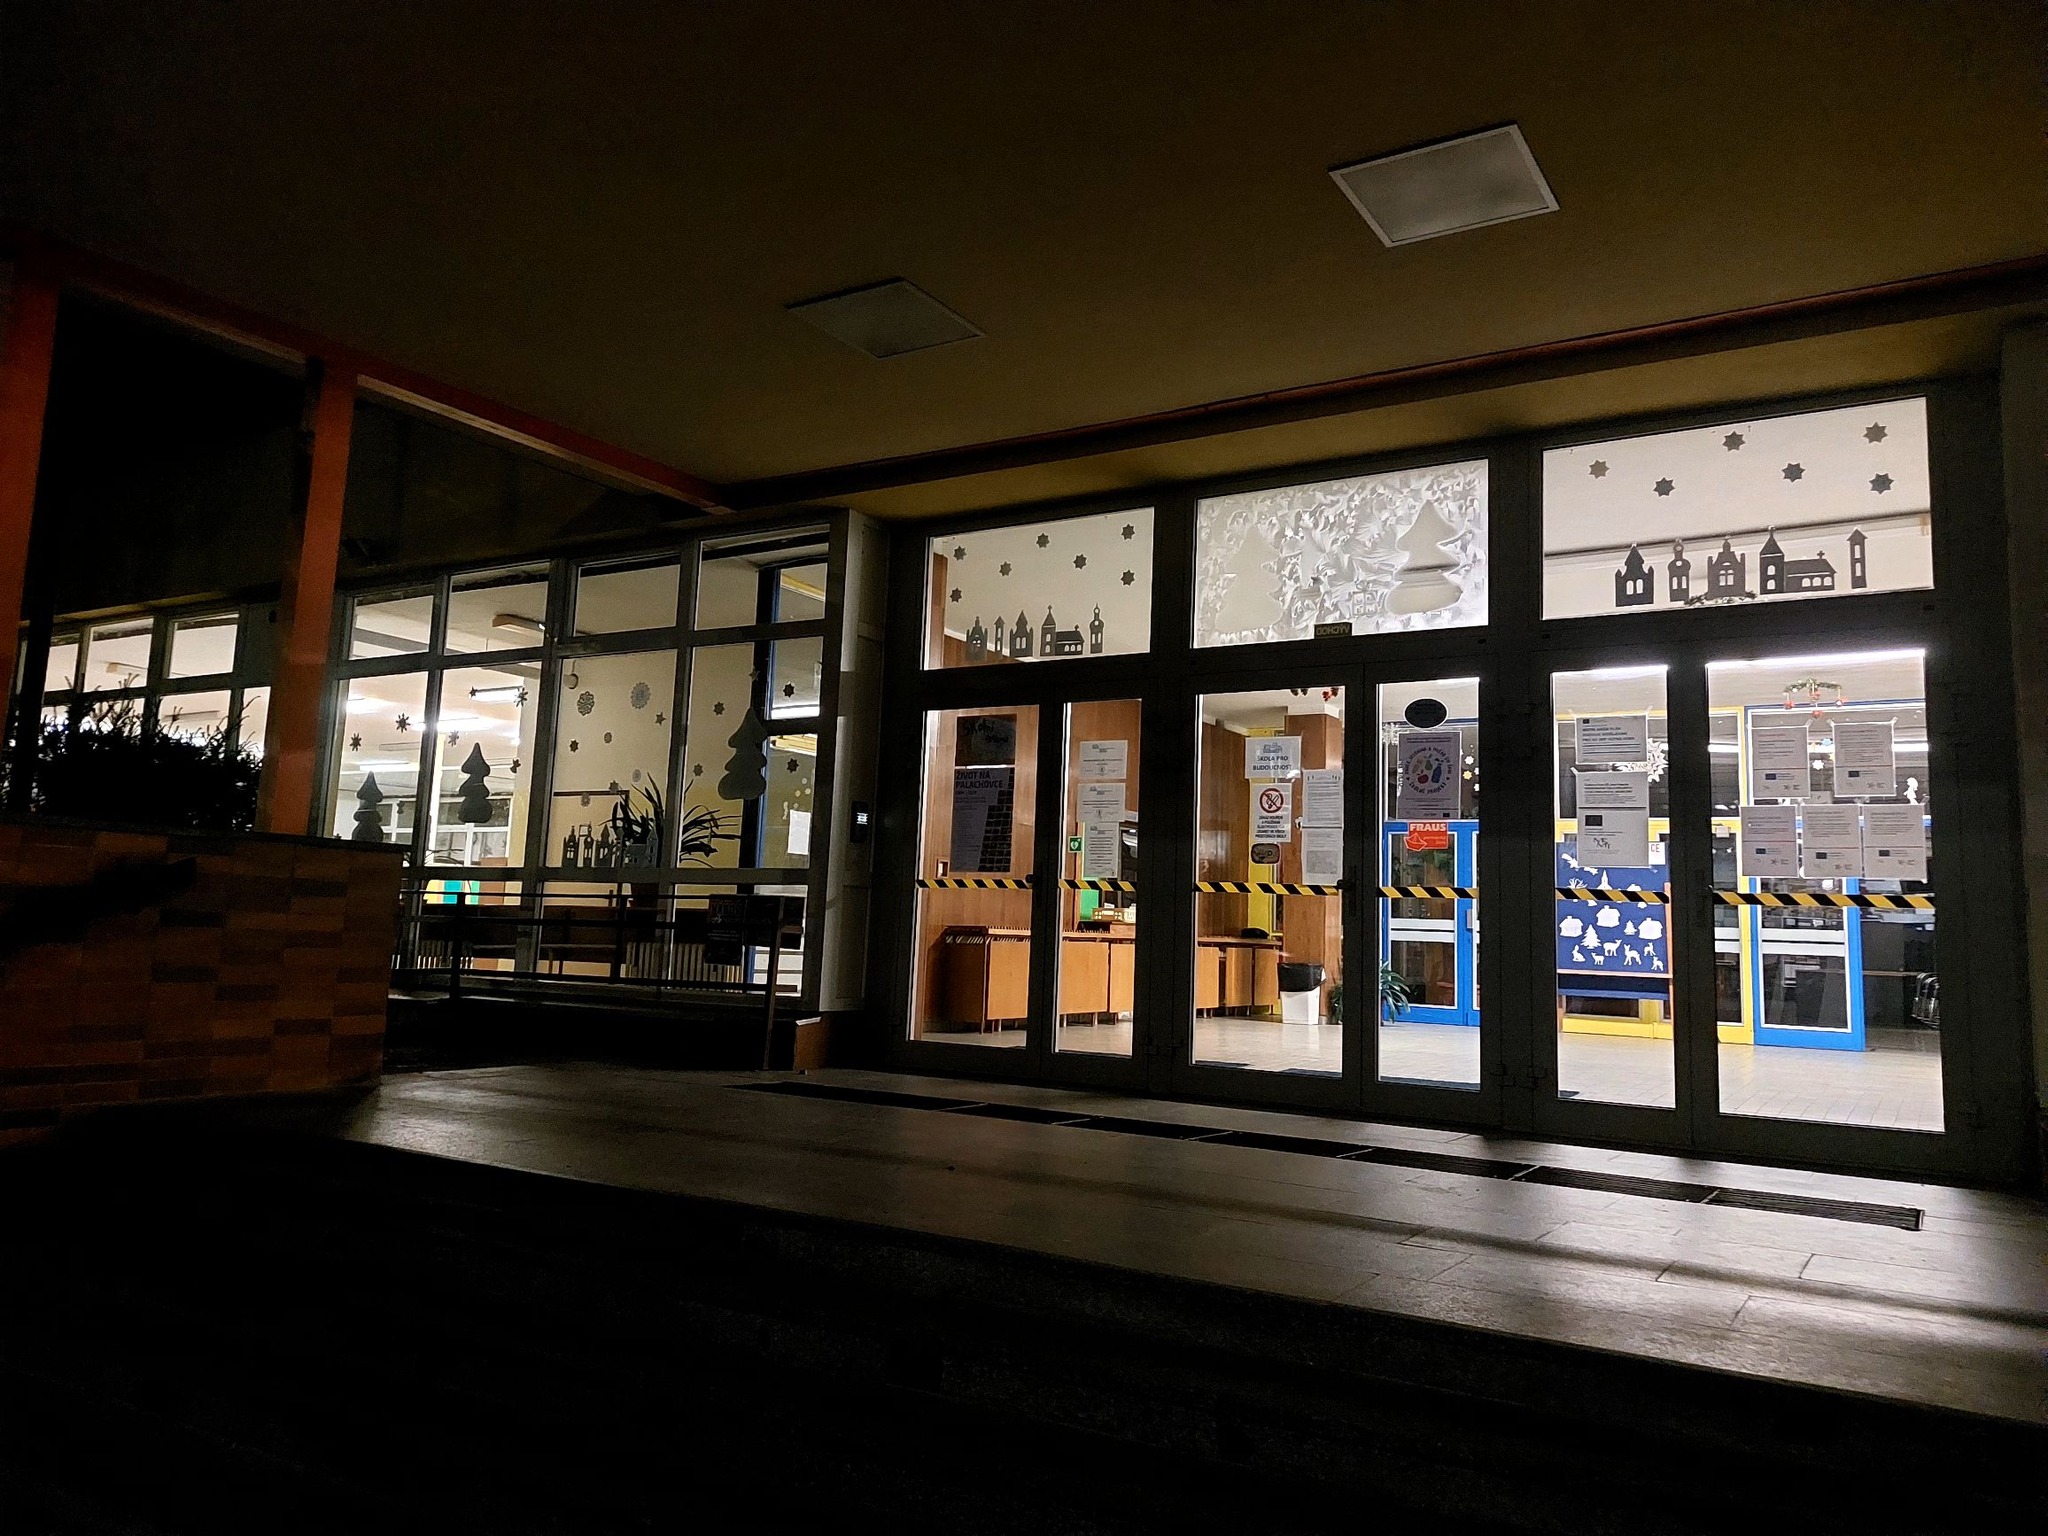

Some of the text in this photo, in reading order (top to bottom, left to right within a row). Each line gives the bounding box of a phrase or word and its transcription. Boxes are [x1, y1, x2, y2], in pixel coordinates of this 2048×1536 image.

[956, 770, 991, 780] ŽIVOT NA
[955, 779, 1004, 789] PALACHOVCE
[1409, 823, 1446, 832] FRAUS
